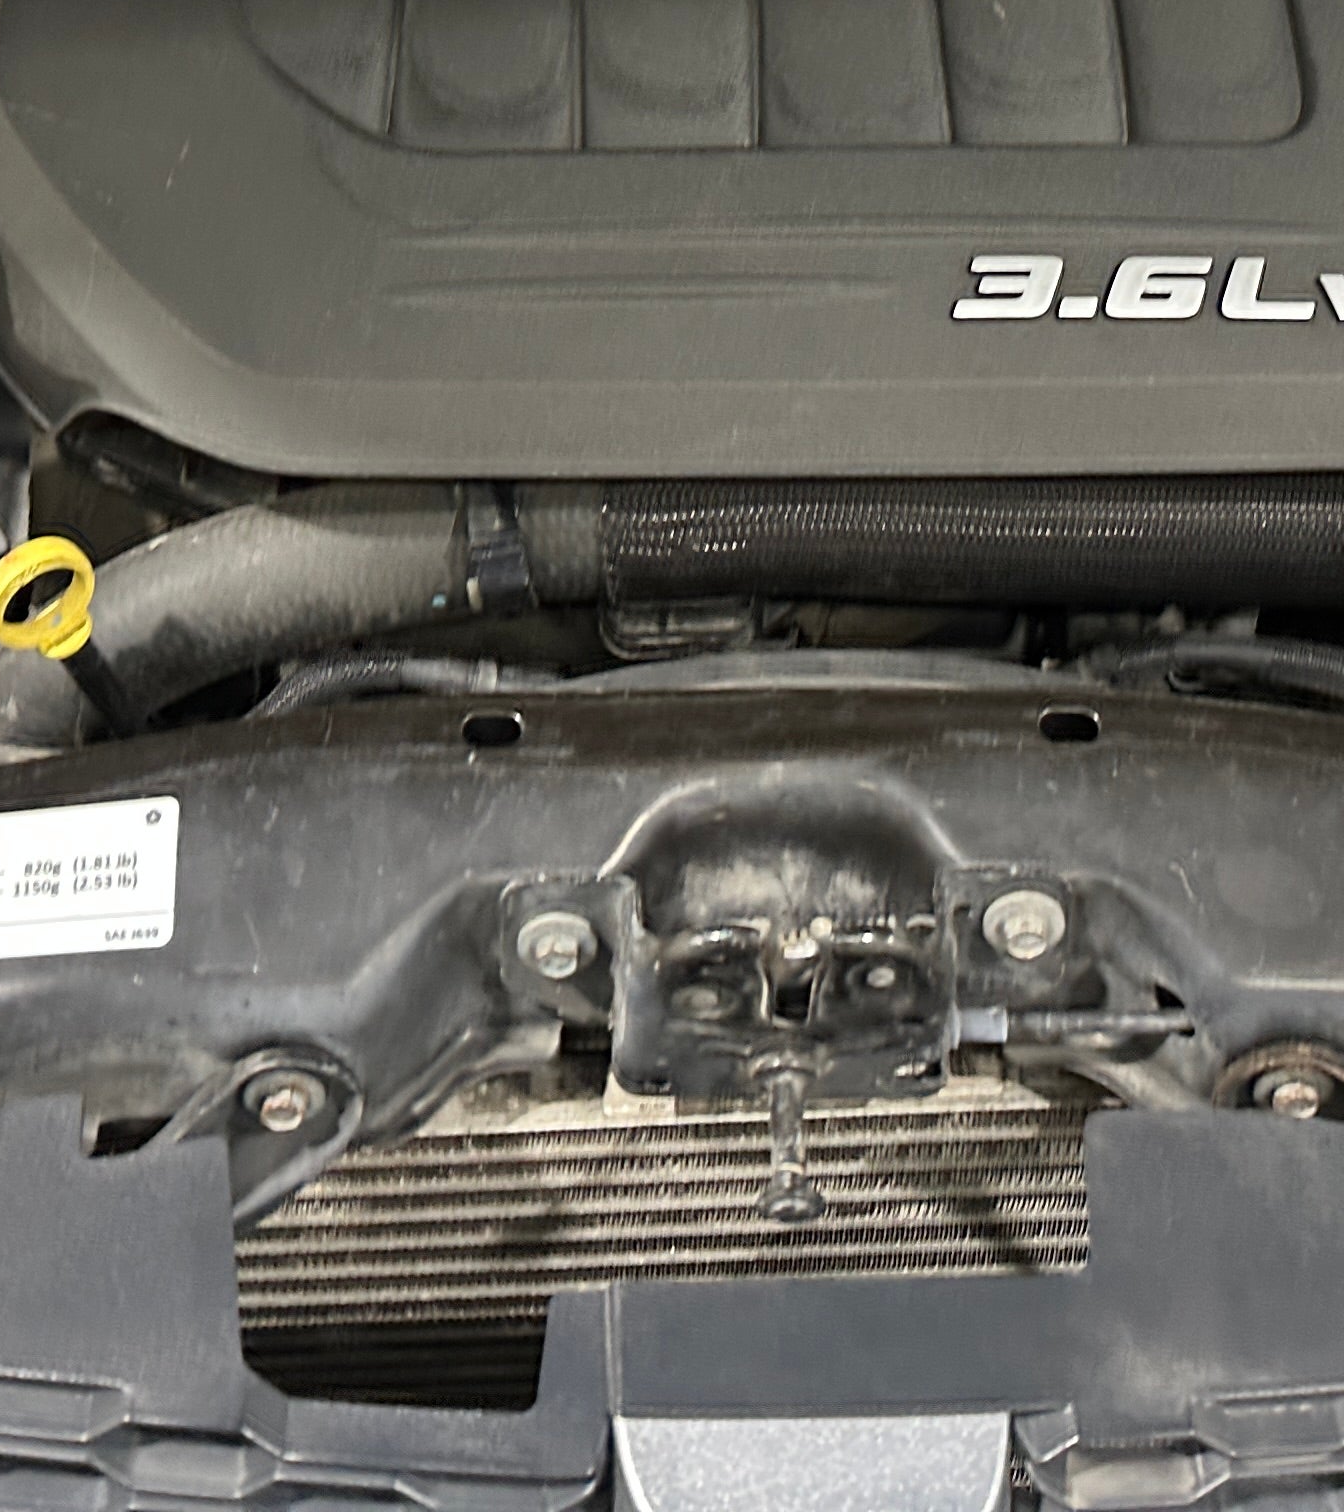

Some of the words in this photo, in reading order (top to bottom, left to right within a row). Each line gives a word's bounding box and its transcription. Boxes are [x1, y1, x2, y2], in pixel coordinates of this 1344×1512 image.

[24, 861, 61, 878] 820g
[116, 851, 138, 870] lb)
[13, 881, 60, 899] 1150g
[118, 872, 138, 890] lb)
